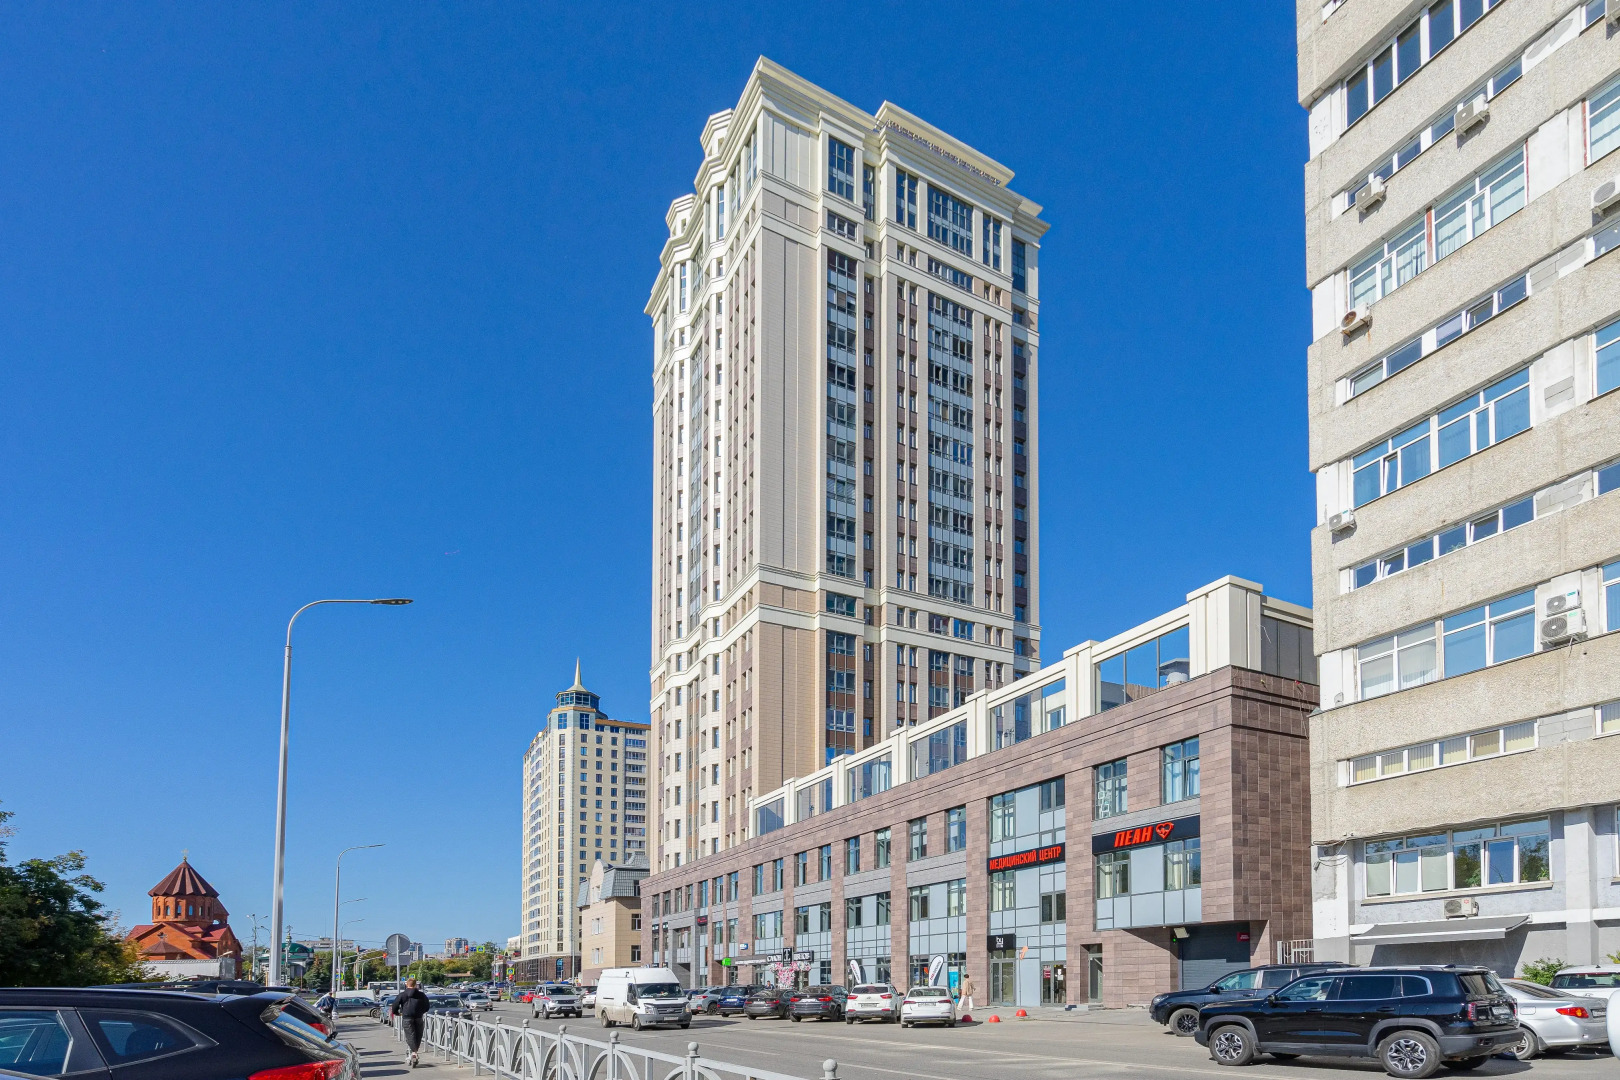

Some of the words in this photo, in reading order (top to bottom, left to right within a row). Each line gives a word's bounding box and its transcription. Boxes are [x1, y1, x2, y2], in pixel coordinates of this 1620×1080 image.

[1114, 825, 1154, 847] ПЕАН
[989, 849, 1037, 870] МЕДИЦИНСКИЙ
[1039, 846, 1062, 861] ЦЕНТР
